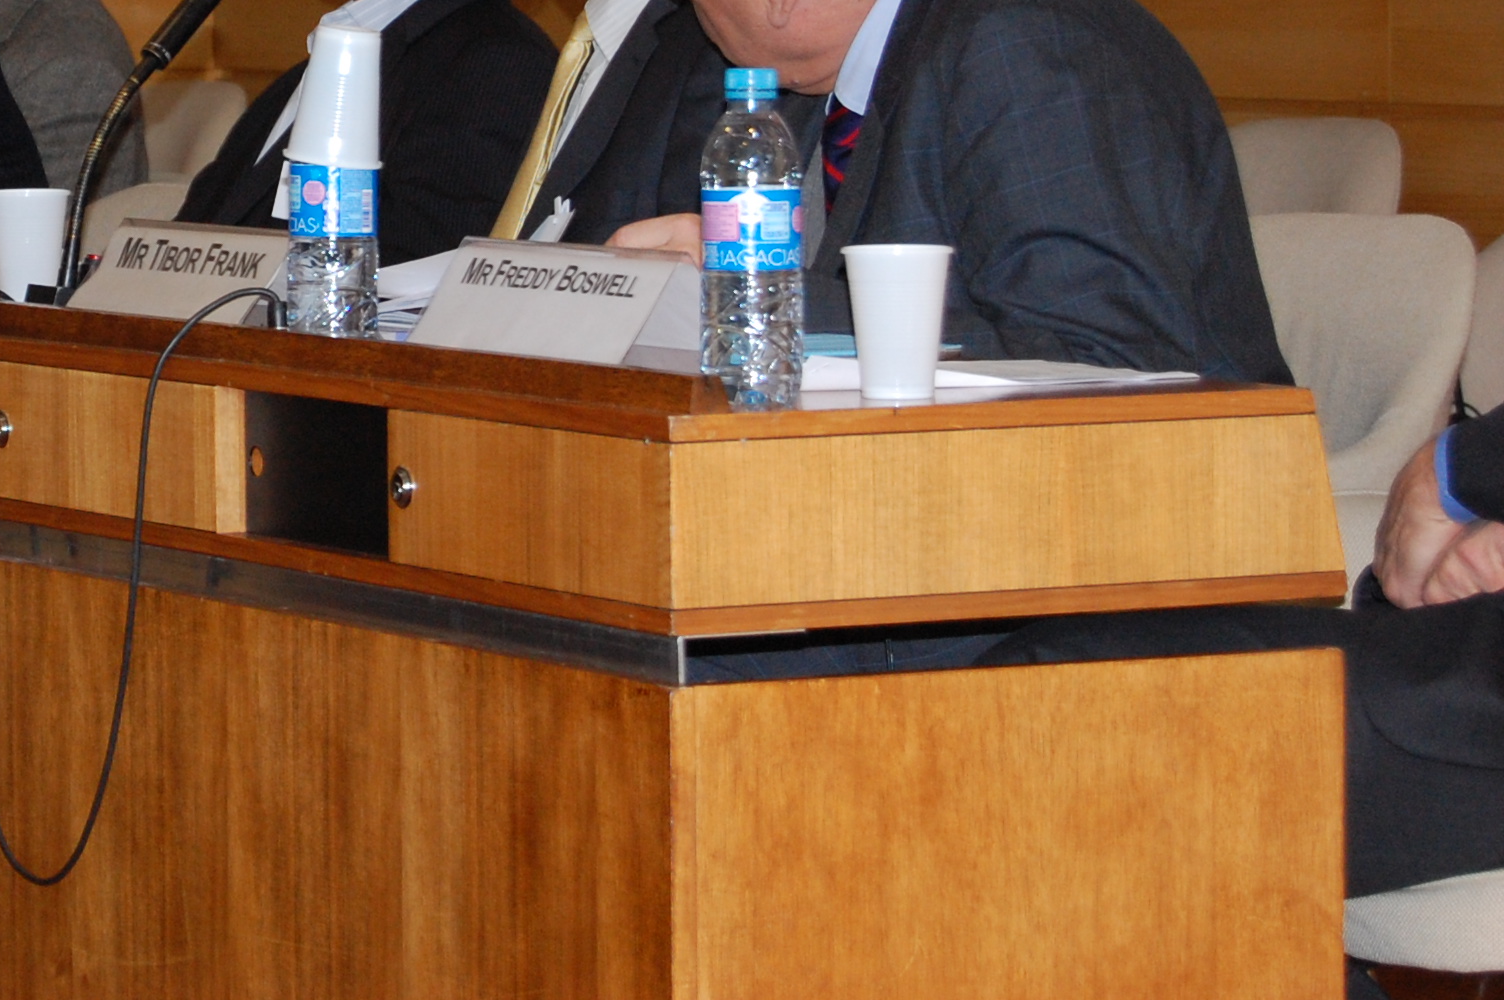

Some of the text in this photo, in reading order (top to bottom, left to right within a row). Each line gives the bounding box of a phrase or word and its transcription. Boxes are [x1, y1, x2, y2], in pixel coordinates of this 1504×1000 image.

[148, 239, 202, 275] TIBOR
[198, 243, 267, 280] FRANK
[489, 259, 561, 291] FREDDY
[554, 264, 638, 298] BOSWELL
